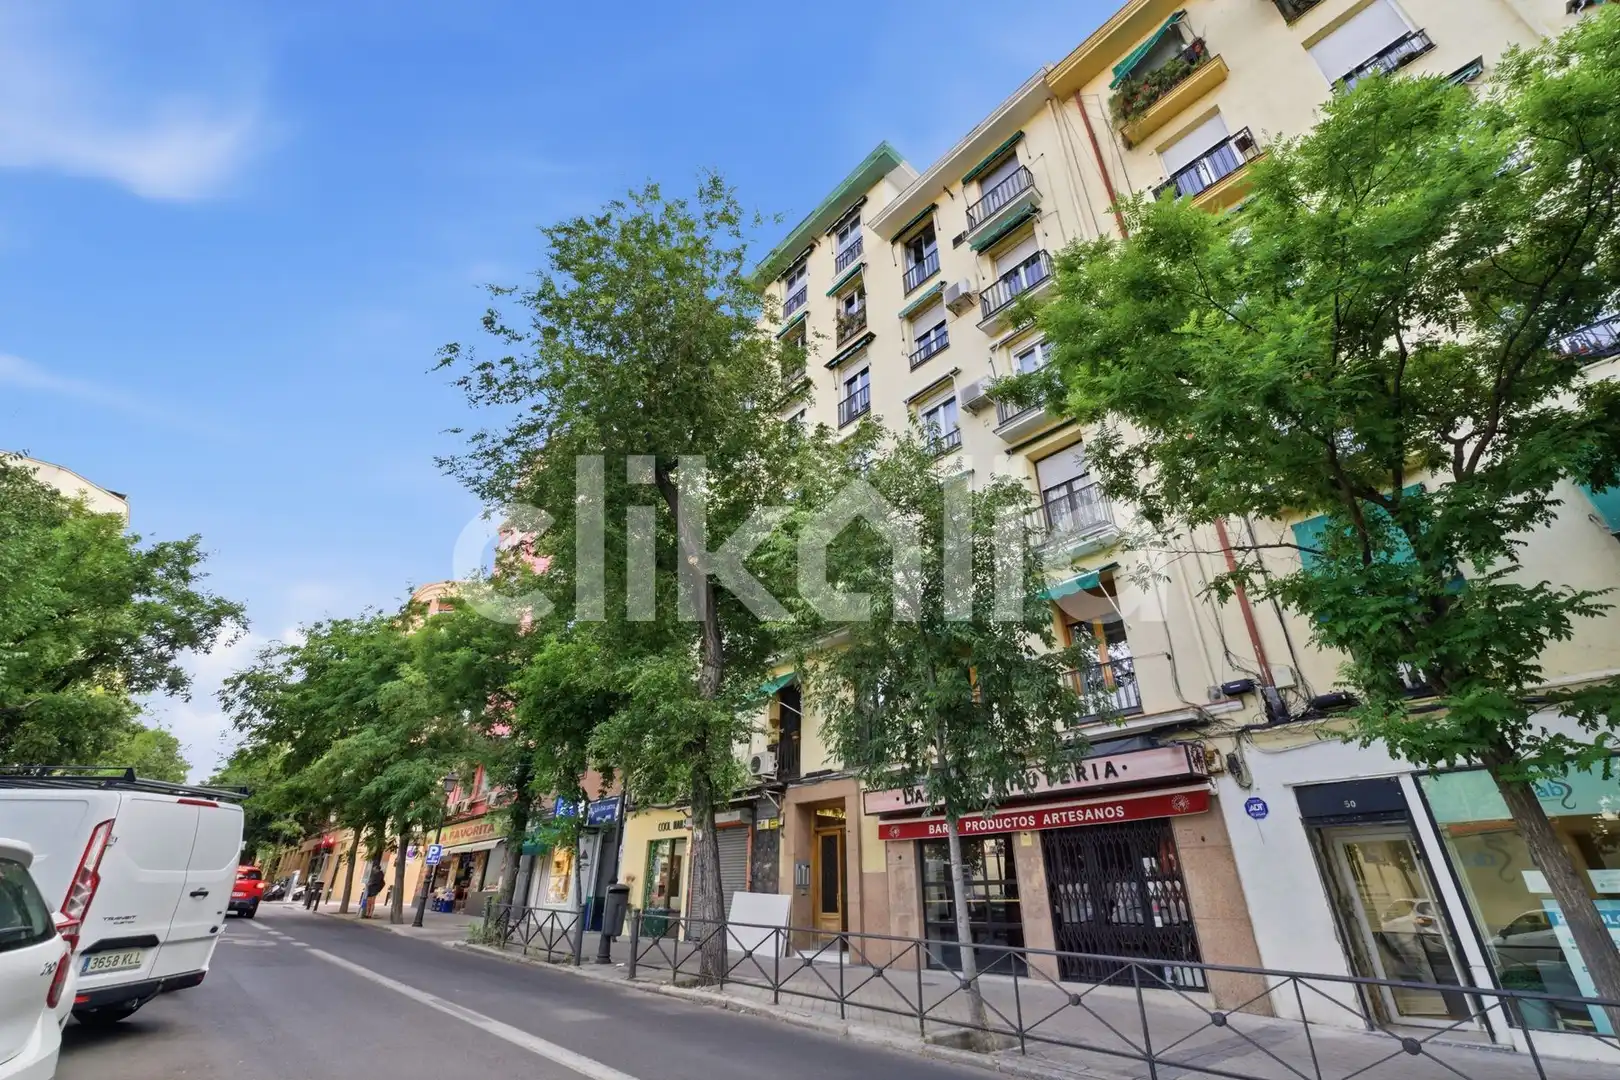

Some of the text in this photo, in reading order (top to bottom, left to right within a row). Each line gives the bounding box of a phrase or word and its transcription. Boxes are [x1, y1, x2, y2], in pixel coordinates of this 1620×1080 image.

[1248, 803, 1264, 812] ADT
[1344, 800, 1357, 808] 50
[928, 805, 1125, 835] BAR PRODUCTOS ARTESANOS
[449, 823, 495, 840] FAVORITA
[428, 846, 440, 858] P
[90, 952, 141, 970] 3658 KLL
